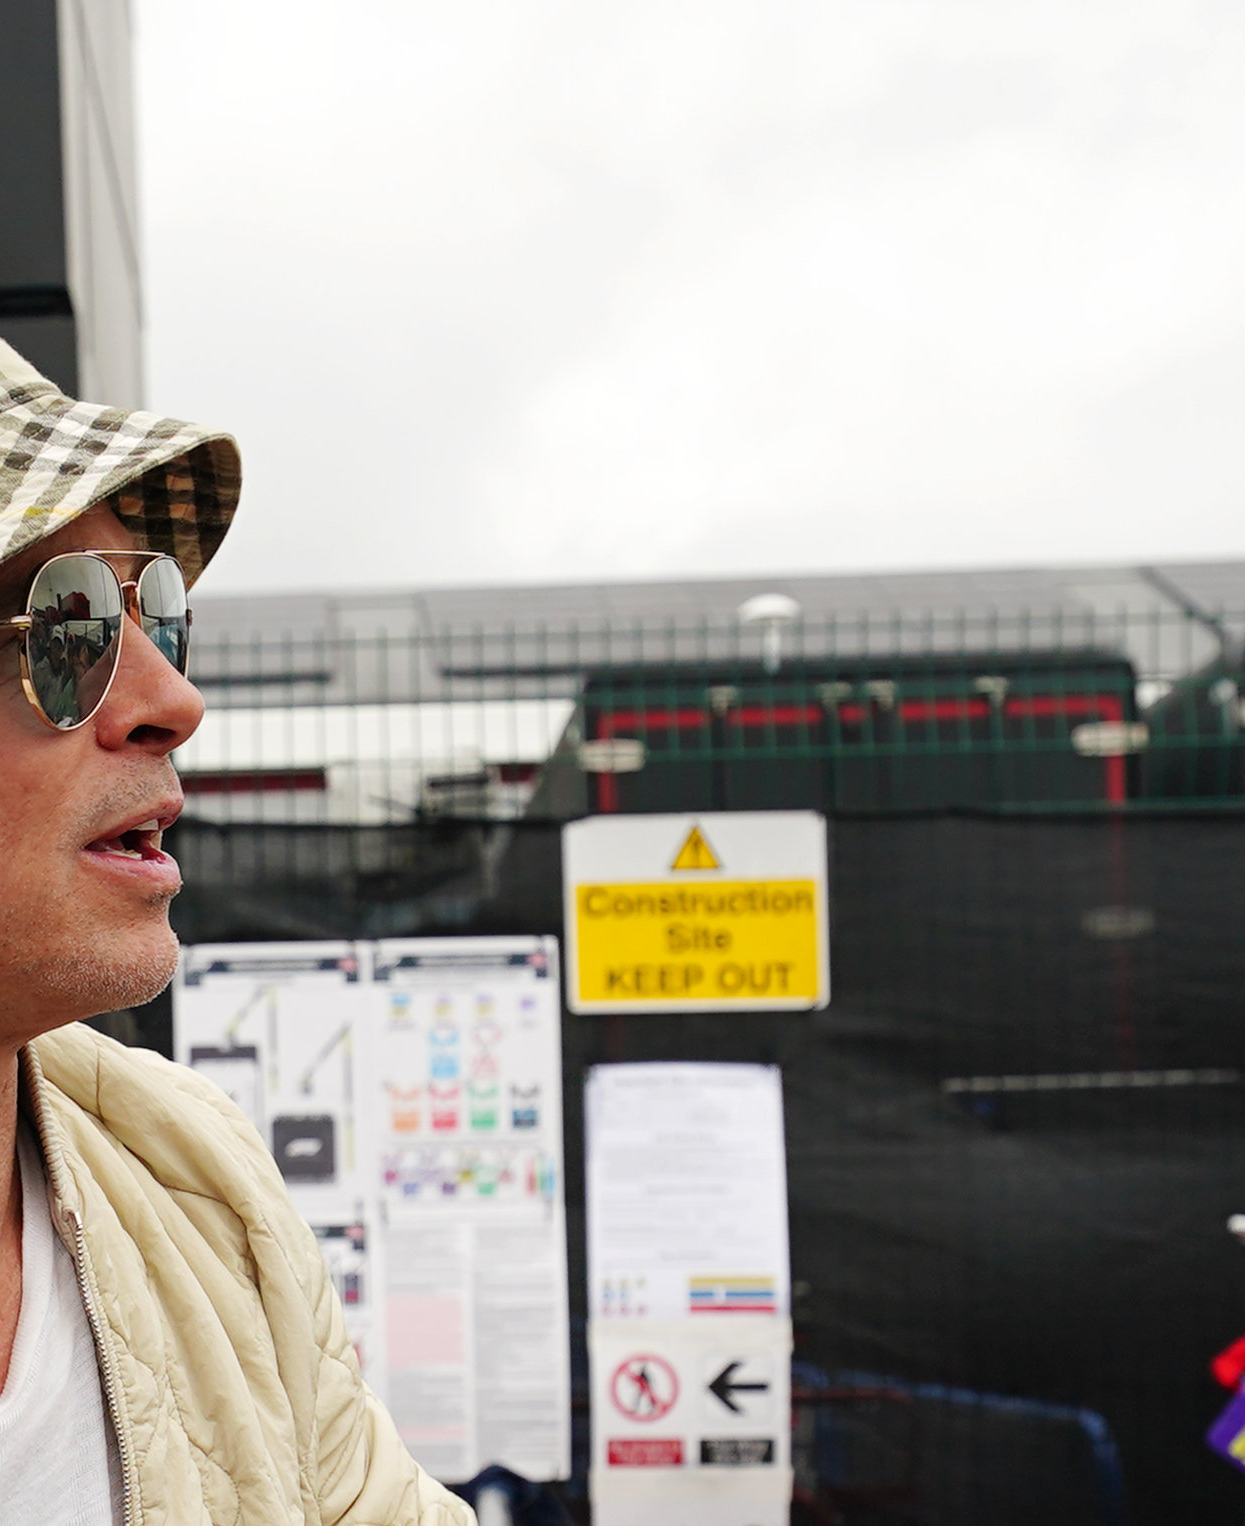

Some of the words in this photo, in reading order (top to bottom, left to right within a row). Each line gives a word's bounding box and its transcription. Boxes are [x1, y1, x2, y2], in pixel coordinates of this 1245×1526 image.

[584, 885, 813, 917] Construction
[666, 923, 732, 954] Site
[606, 964, 704, 994] KEEP
[716, 961, 794, 993] OUT
